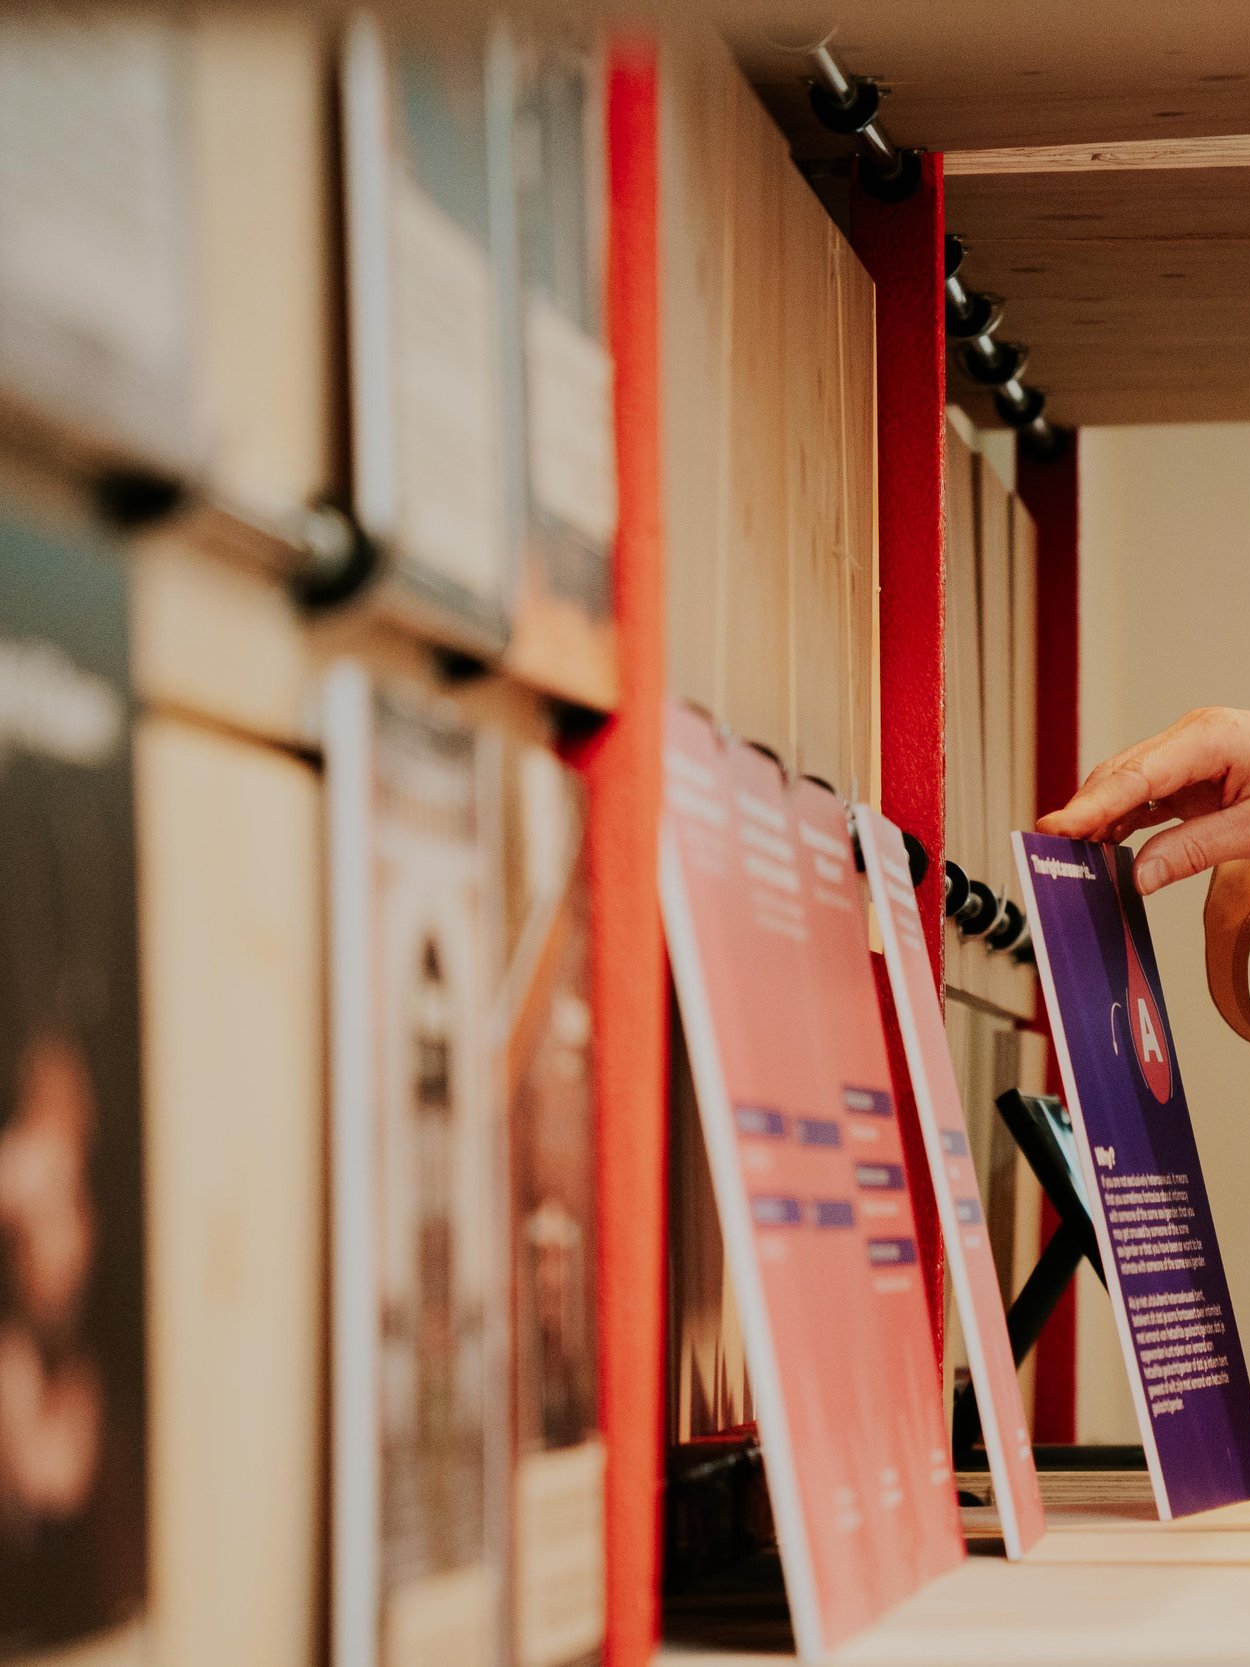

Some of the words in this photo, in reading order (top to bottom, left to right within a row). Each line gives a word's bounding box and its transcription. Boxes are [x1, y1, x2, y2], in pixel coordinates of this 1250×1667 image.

[1031, 854, 1046, 874] The
[1044, 857, 1062, 879] right
[1060, 863, 1084, 878] answer
[1137, 998, 1163, 1062] A
[1094, 1147, 1115, 1168] Why?
